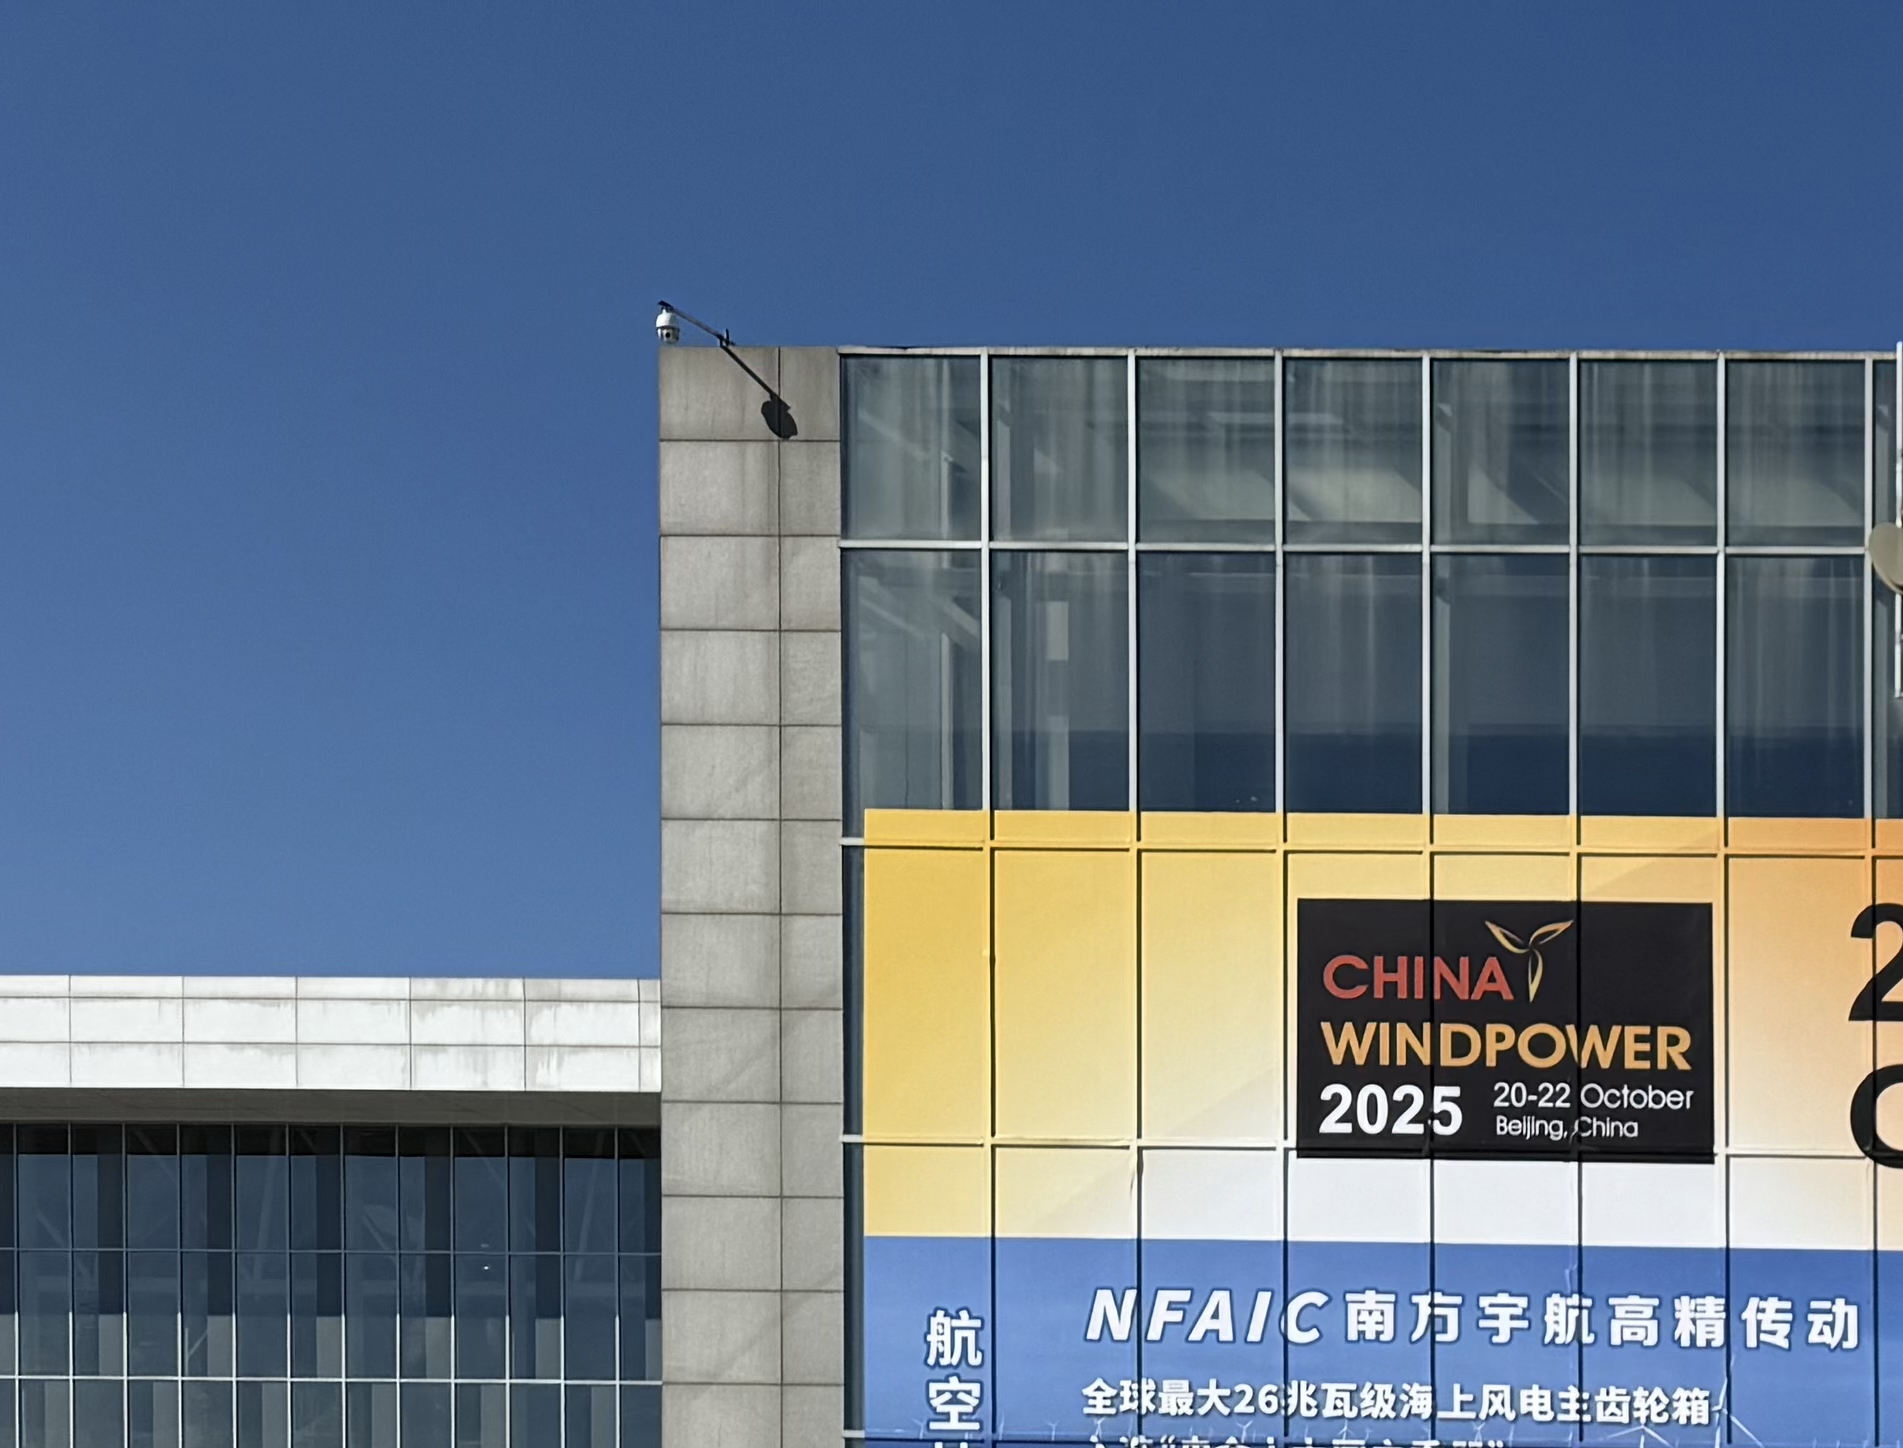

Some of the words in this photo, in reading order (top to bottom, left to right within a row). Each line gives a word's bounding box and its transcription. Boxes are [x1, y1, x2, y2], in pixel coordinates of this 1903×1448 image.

[1323, 955, 1514, 1000] CHINA
[1320, 1021, 1692, 1070] WINDPOWER
[1318, 1083, 1463, 1135] 2025
[1493, 1082, 1571, 1109] 20-22
[1580, 1083, 1694, 1110] October
[1496, 1115, 1568, 1141] Beijing,
[1573, 1115, 1638, 1139] China
[1086, 1289, 1330, 1343] NFAIC
[1345, 1290, 1858, 1350] 南方宇航高精传动
[1082, 1377, 1711, 1426] 全球最大26兆瓦级海上风电主齿轮箱
